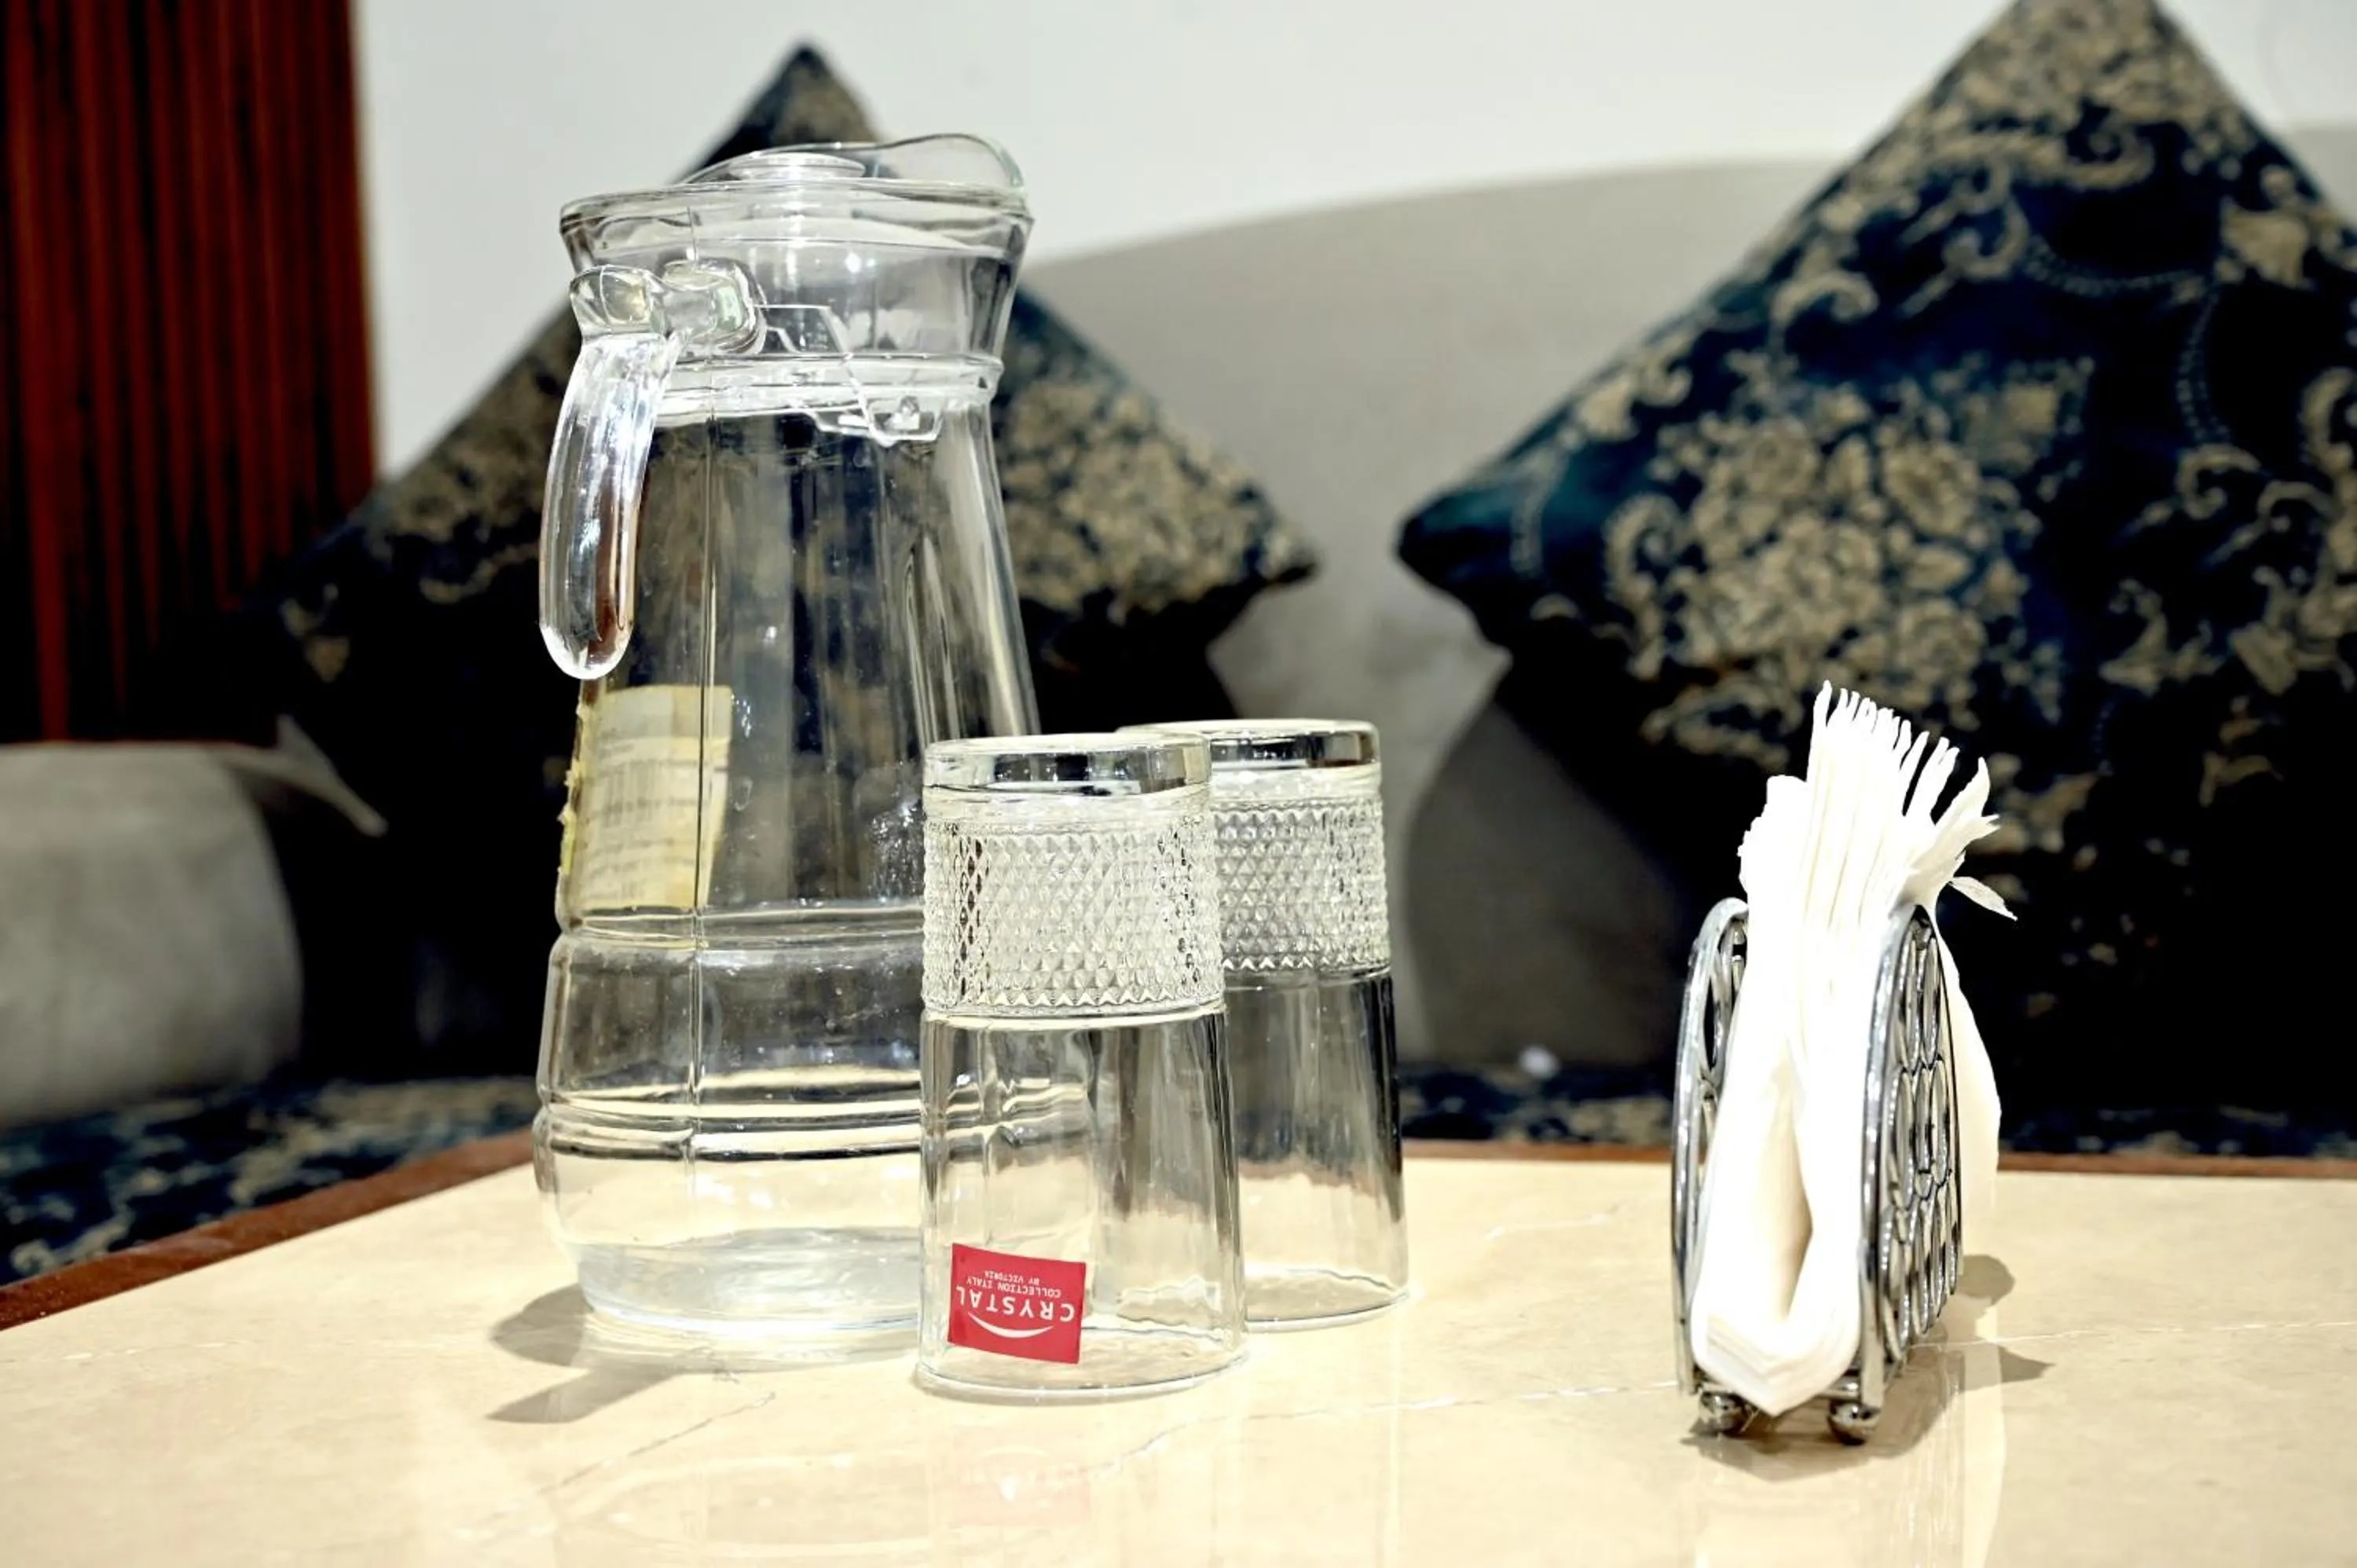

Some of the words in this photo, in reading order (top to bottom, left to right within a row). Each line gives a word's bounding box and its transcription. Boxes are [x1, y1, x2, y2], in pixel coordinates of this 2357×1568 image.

[966, 1277, 993, 1289] ITALY
[984, 1270, 1024, 1283] VICTORIA
[998, 1282, 1061, 1298] COLLECTION
[956, 1285, 1075, 1322] CRYSTAL
